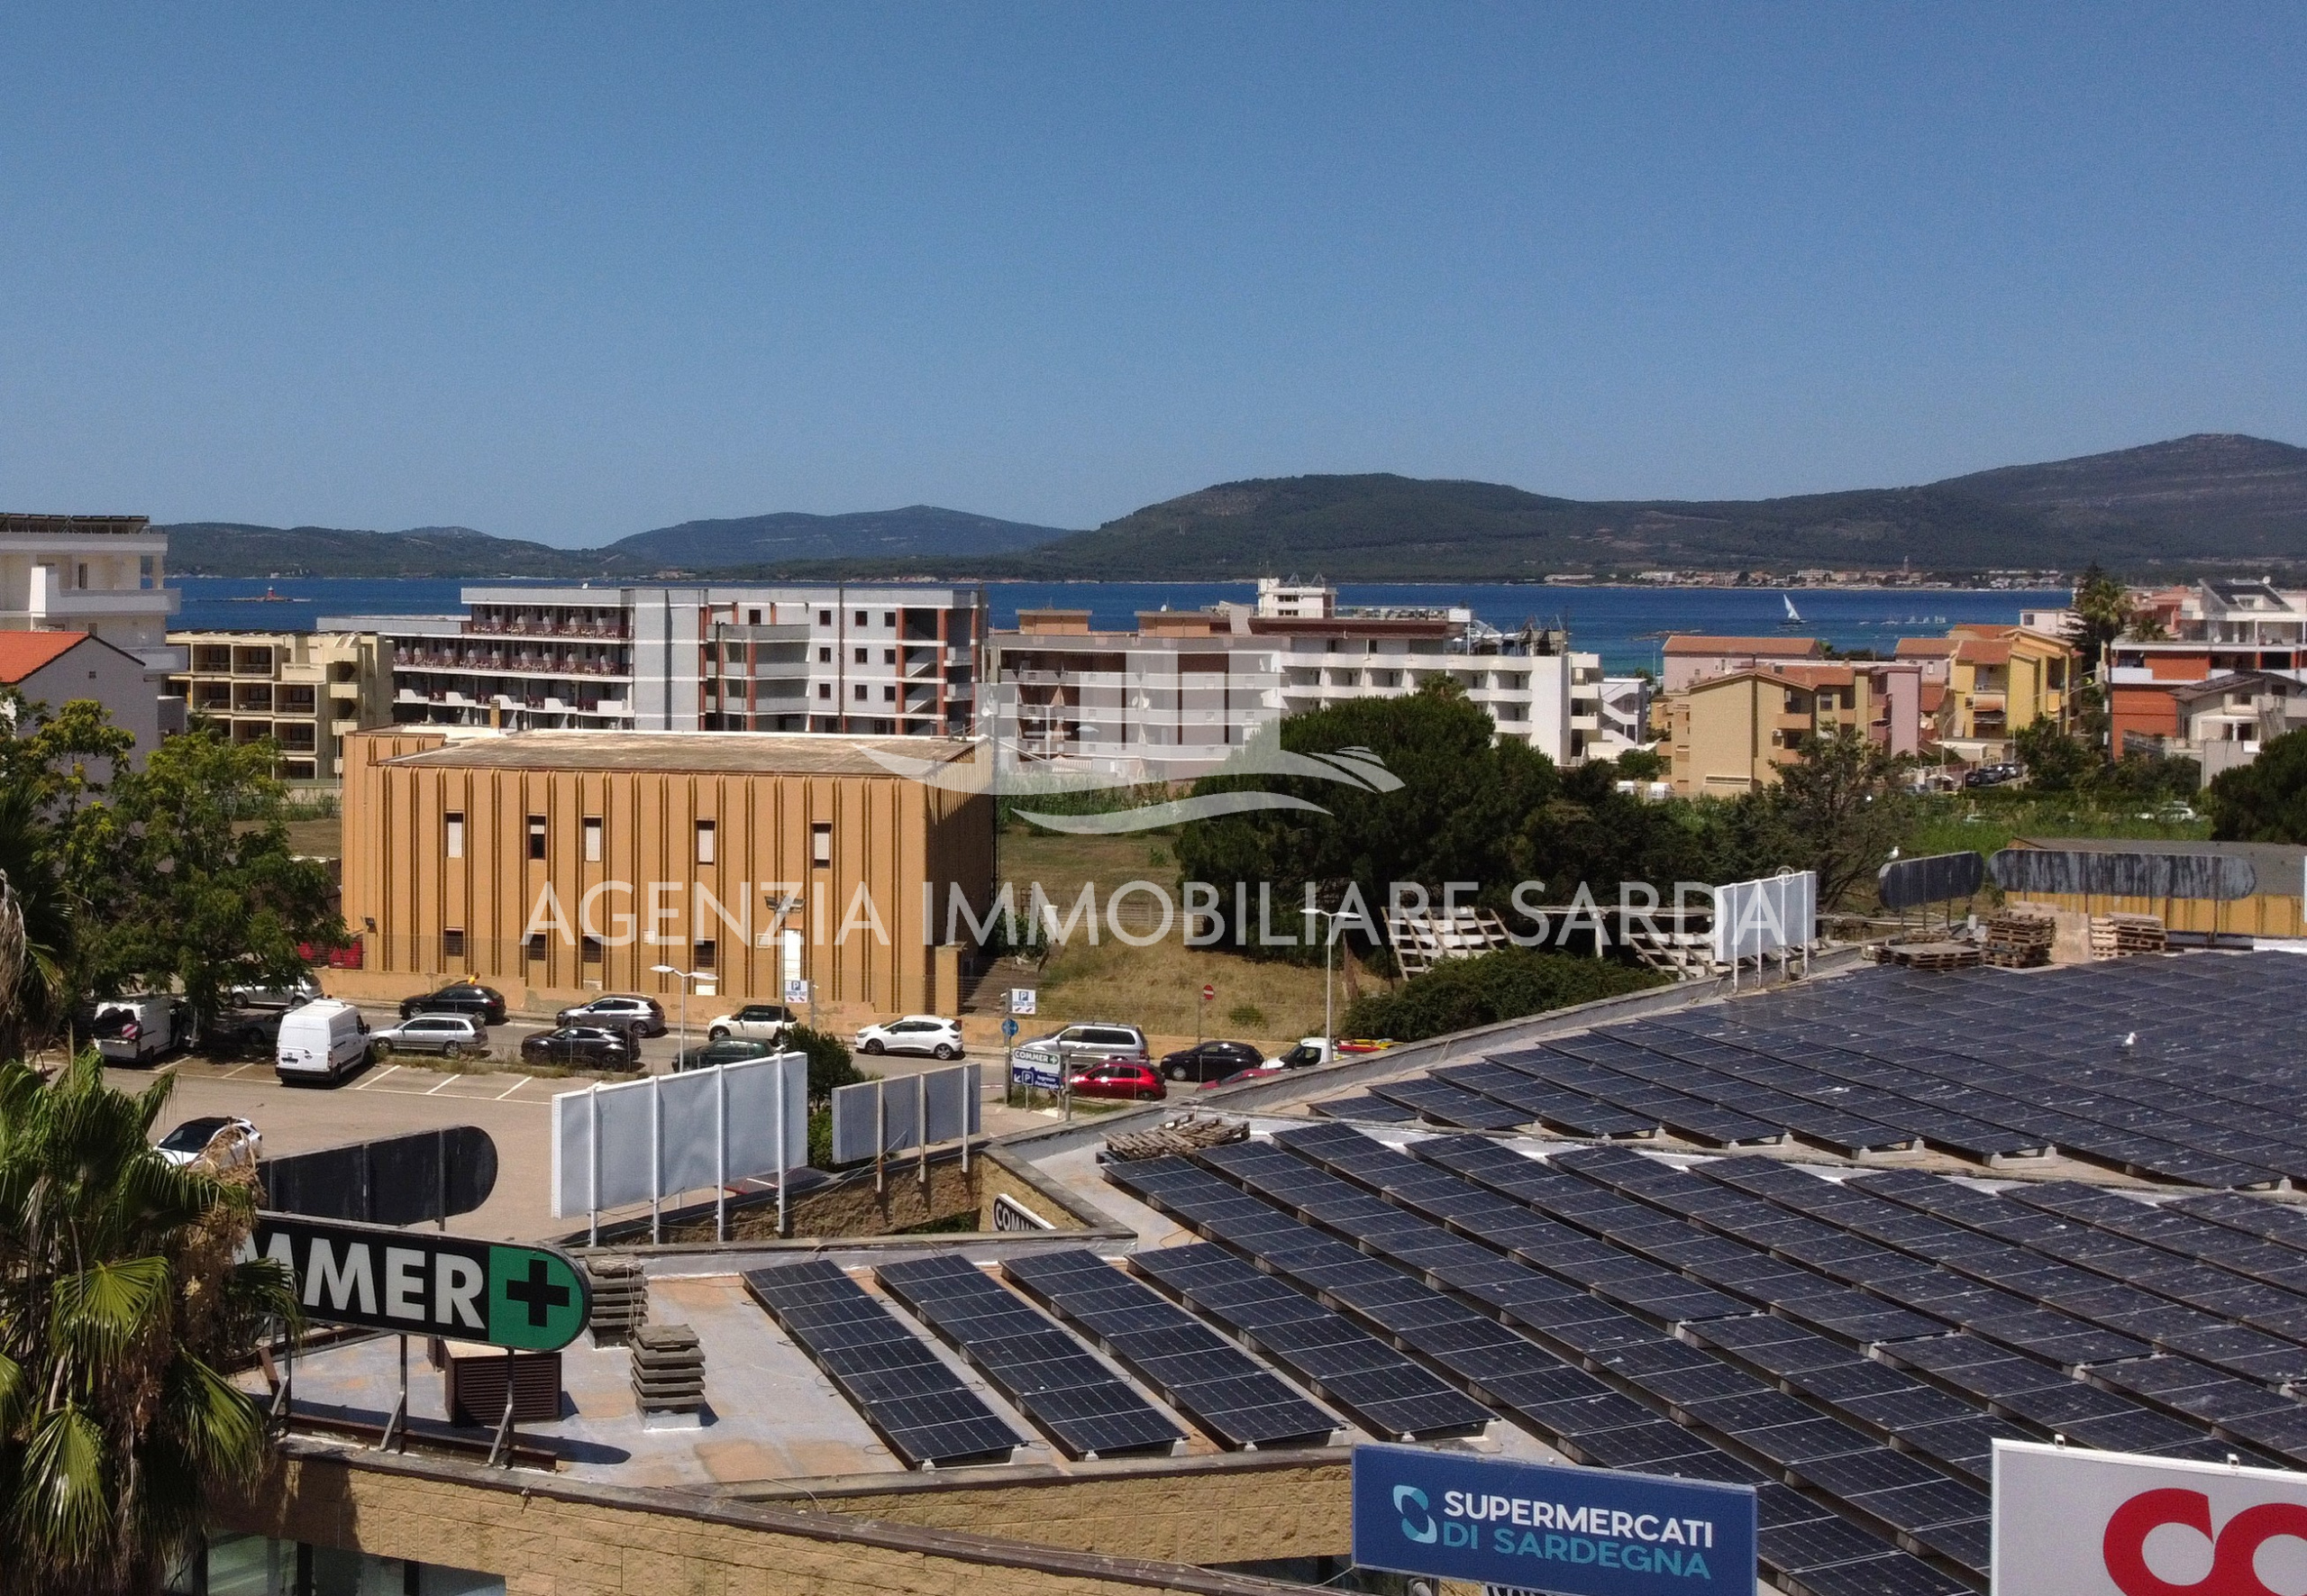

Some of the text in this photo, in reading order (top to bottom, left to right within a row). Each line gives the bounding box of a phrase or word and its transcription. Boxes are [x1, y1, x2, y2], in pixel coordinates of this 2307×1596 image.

[1015, 1050, 1049, 1062] COMMER
[232, 1228, 487, 1330] MMER
[1444, 1490, 1713, 1548] SUPERMERCATI
[1443, 1521, 1711, 1580] DI SARDEGNA
